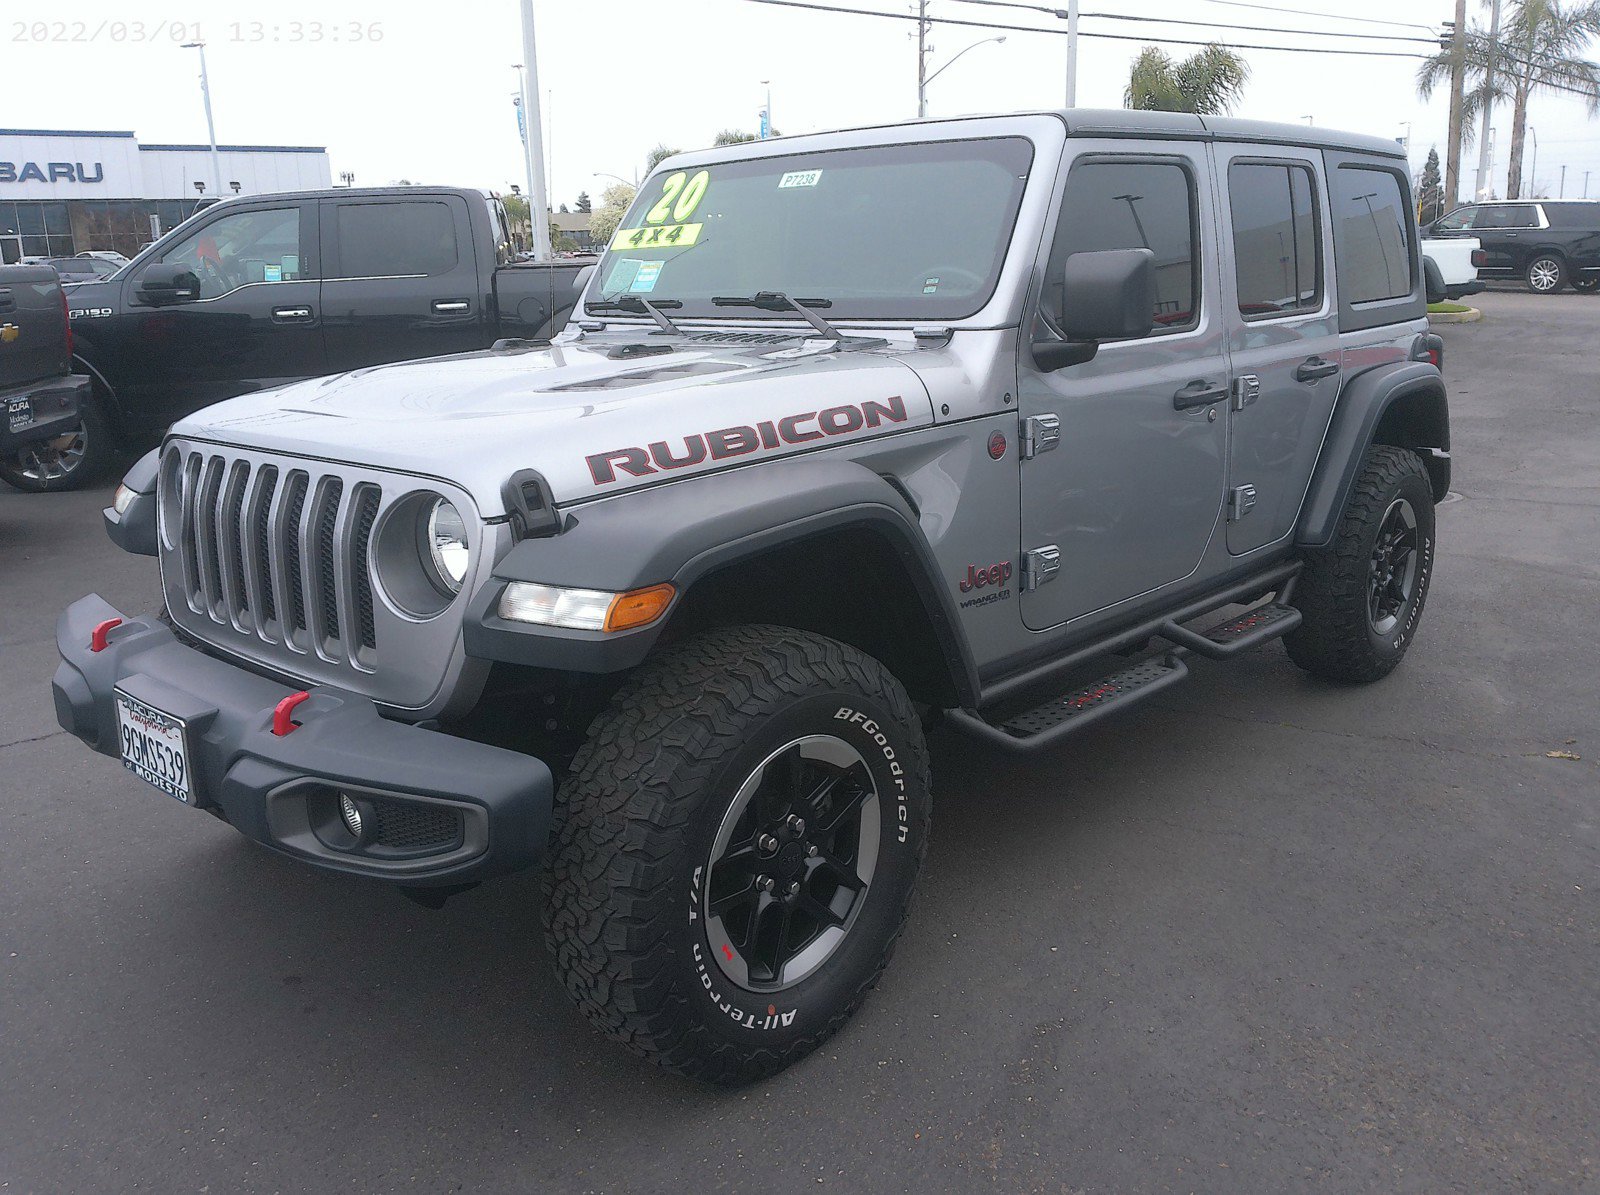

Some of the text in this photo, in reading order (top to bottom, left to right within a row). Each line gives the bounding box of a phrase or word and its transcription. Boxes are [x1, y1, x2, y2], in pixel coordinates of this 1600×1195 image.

[646, 170, 710, 224] 20
[783, 173, 817, 187] P7238
[8, 401, 30, 414] ACURA
[585, 395, 908, 486] RUBICON
[960, 560, 1013, 593] Jeep
[960, 589, 1011, 609] WRANGLER
[132, 702, 164, 727] ACURA
[122, 723, 184, 787] 9GMS539
[135, 765, 188, 801] MODESTO
[833, 707, 909, 843] BFGoodrich
[688, 865, 798, 1030] All-Terrain T/A
